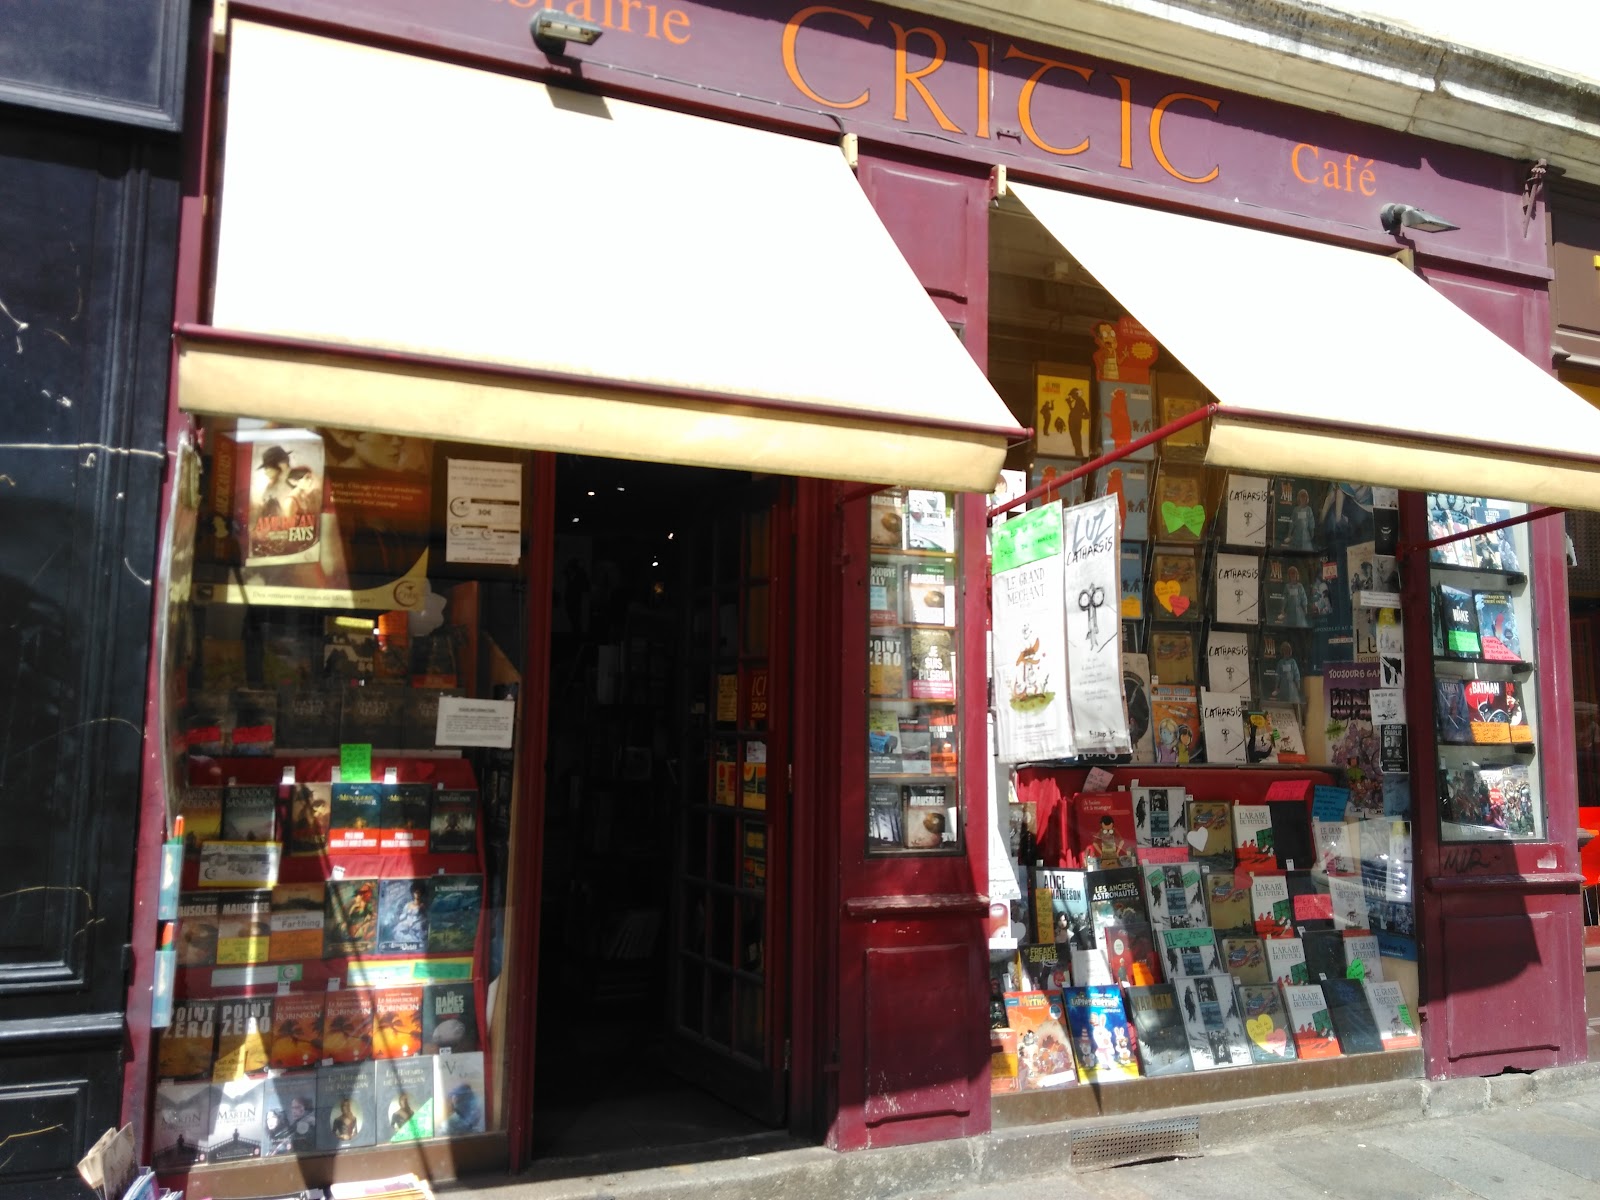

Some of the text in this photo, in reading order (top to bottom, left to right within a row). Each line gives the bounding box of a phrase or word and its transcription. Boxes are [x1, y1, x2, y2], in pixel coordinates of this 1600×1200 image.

[507, 0, 692, 45] airie
[781, 5, 1222, 185] CRITIC
[1291, 142, 1377, 196] Café
[1229, 489, 1268, 502] CATHARSIS
[288, 526, 315, 542] FAYS
[1073, 508, 1114, 551] LUZ
[1066, 536, 1113, 566] CATHARSIS
[1218, 568, 1259, 580] CATHARSIS
[1208, 645, 1249, 657] CATHARSIS
[1471, 680, 1500, 695] BATMAN
[1204, 707, 1243, 719] CATHARSIS
[1239, 811, 1268, 820] L'ARABE
[1044, 874, 1066, 889] ALICE
[1094, 881, 1136, 893] LES ANCIENS
[1255, 882, 1284, 891] L'ARABE
[1092, 888, 1139, 901] ASTRONAUTES
[178, 904, 218, 917] AUSOLEE
[281, 919, 320, 929] Farthing
[1272, 945, 1300, 955] L'ARABE
[435, 996, 464, 1007] DAMES
[1292, 992, 1319, 1001] L'ARABE
[222, 1002, 271, 1019] POINT
[327, 1006, 371, 1017] ROBINSON
[376, 1003, 420, 1013] ROBINSON
[275, 1010, 321, 1021] ROBINSON
[162, 1020, 213, 1039] ZERO
[221, 1016, 272, 1036] ZERO
[217, 1107, 256, 1120] MARTIN
